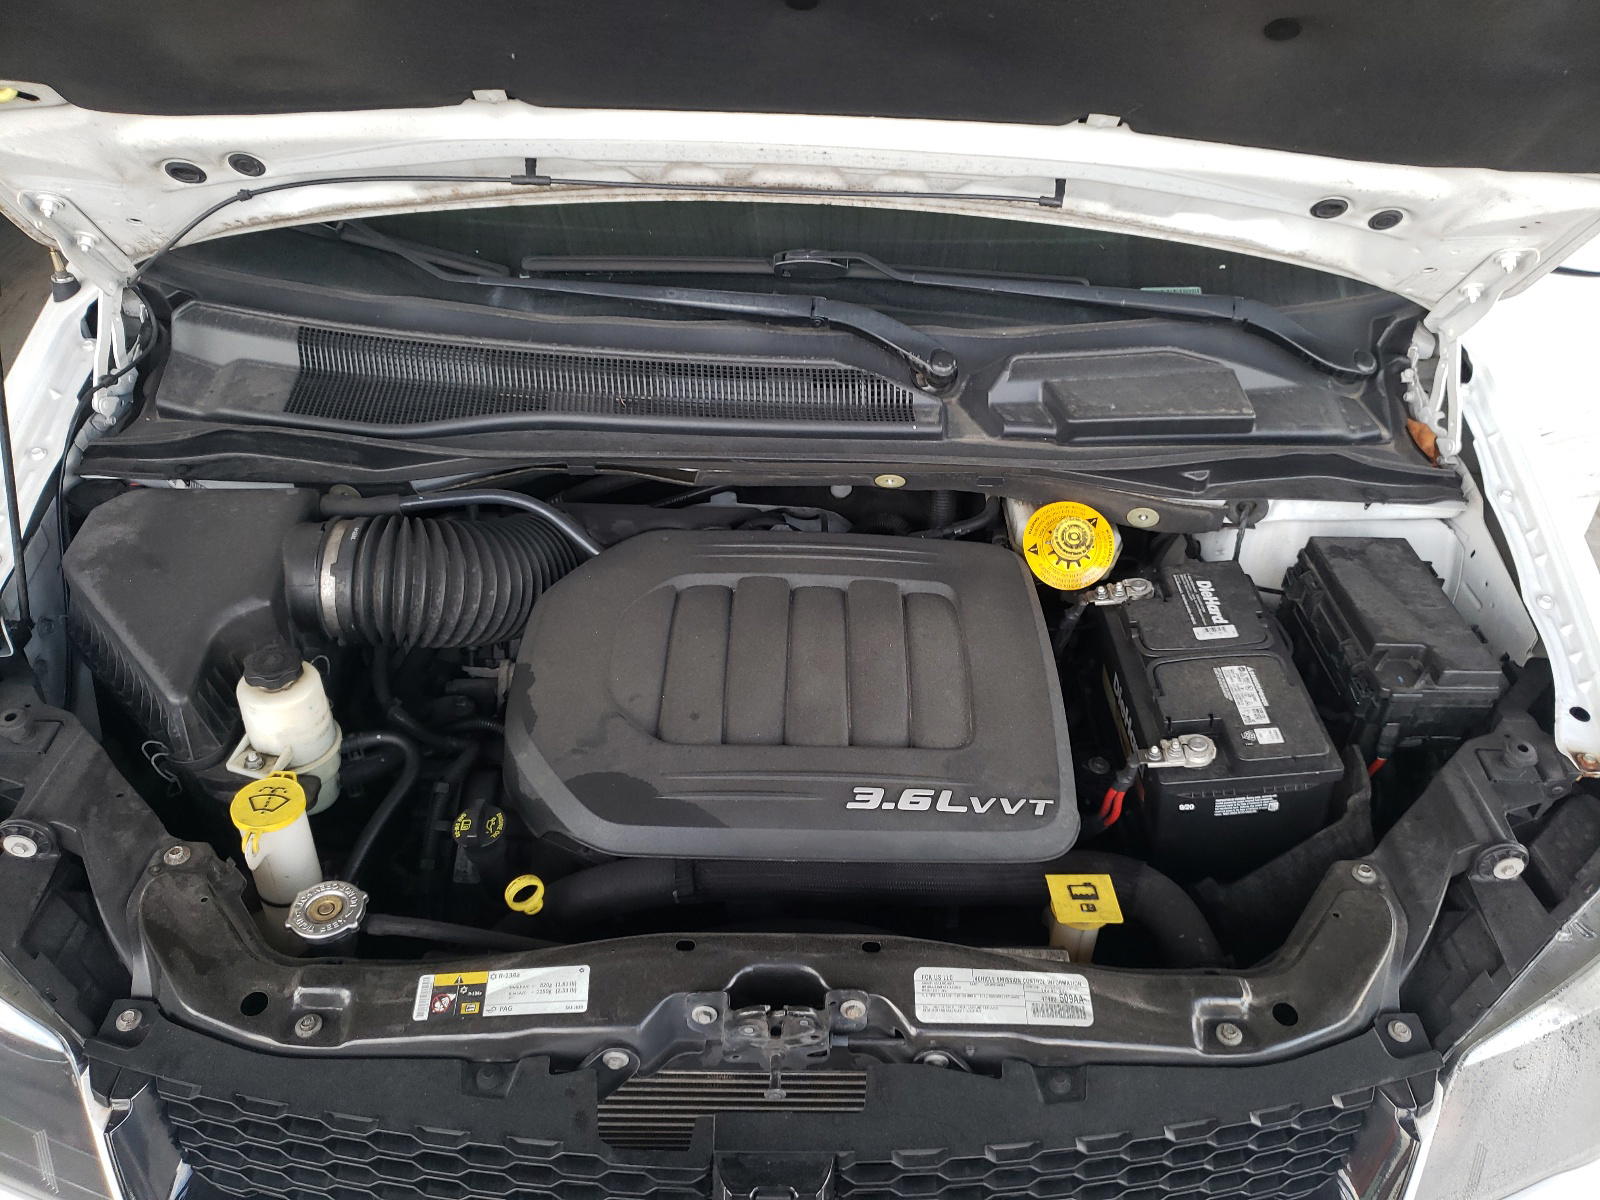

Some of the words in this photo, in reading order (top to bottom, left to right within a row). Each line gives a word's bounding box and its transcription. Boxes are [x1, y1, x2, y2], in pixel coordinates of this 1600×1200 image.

[1196, 580, 1230, 624] DieHard
[846, 786, 968, 813] 3.6L
[969, 796, 1055, 816] VVT
